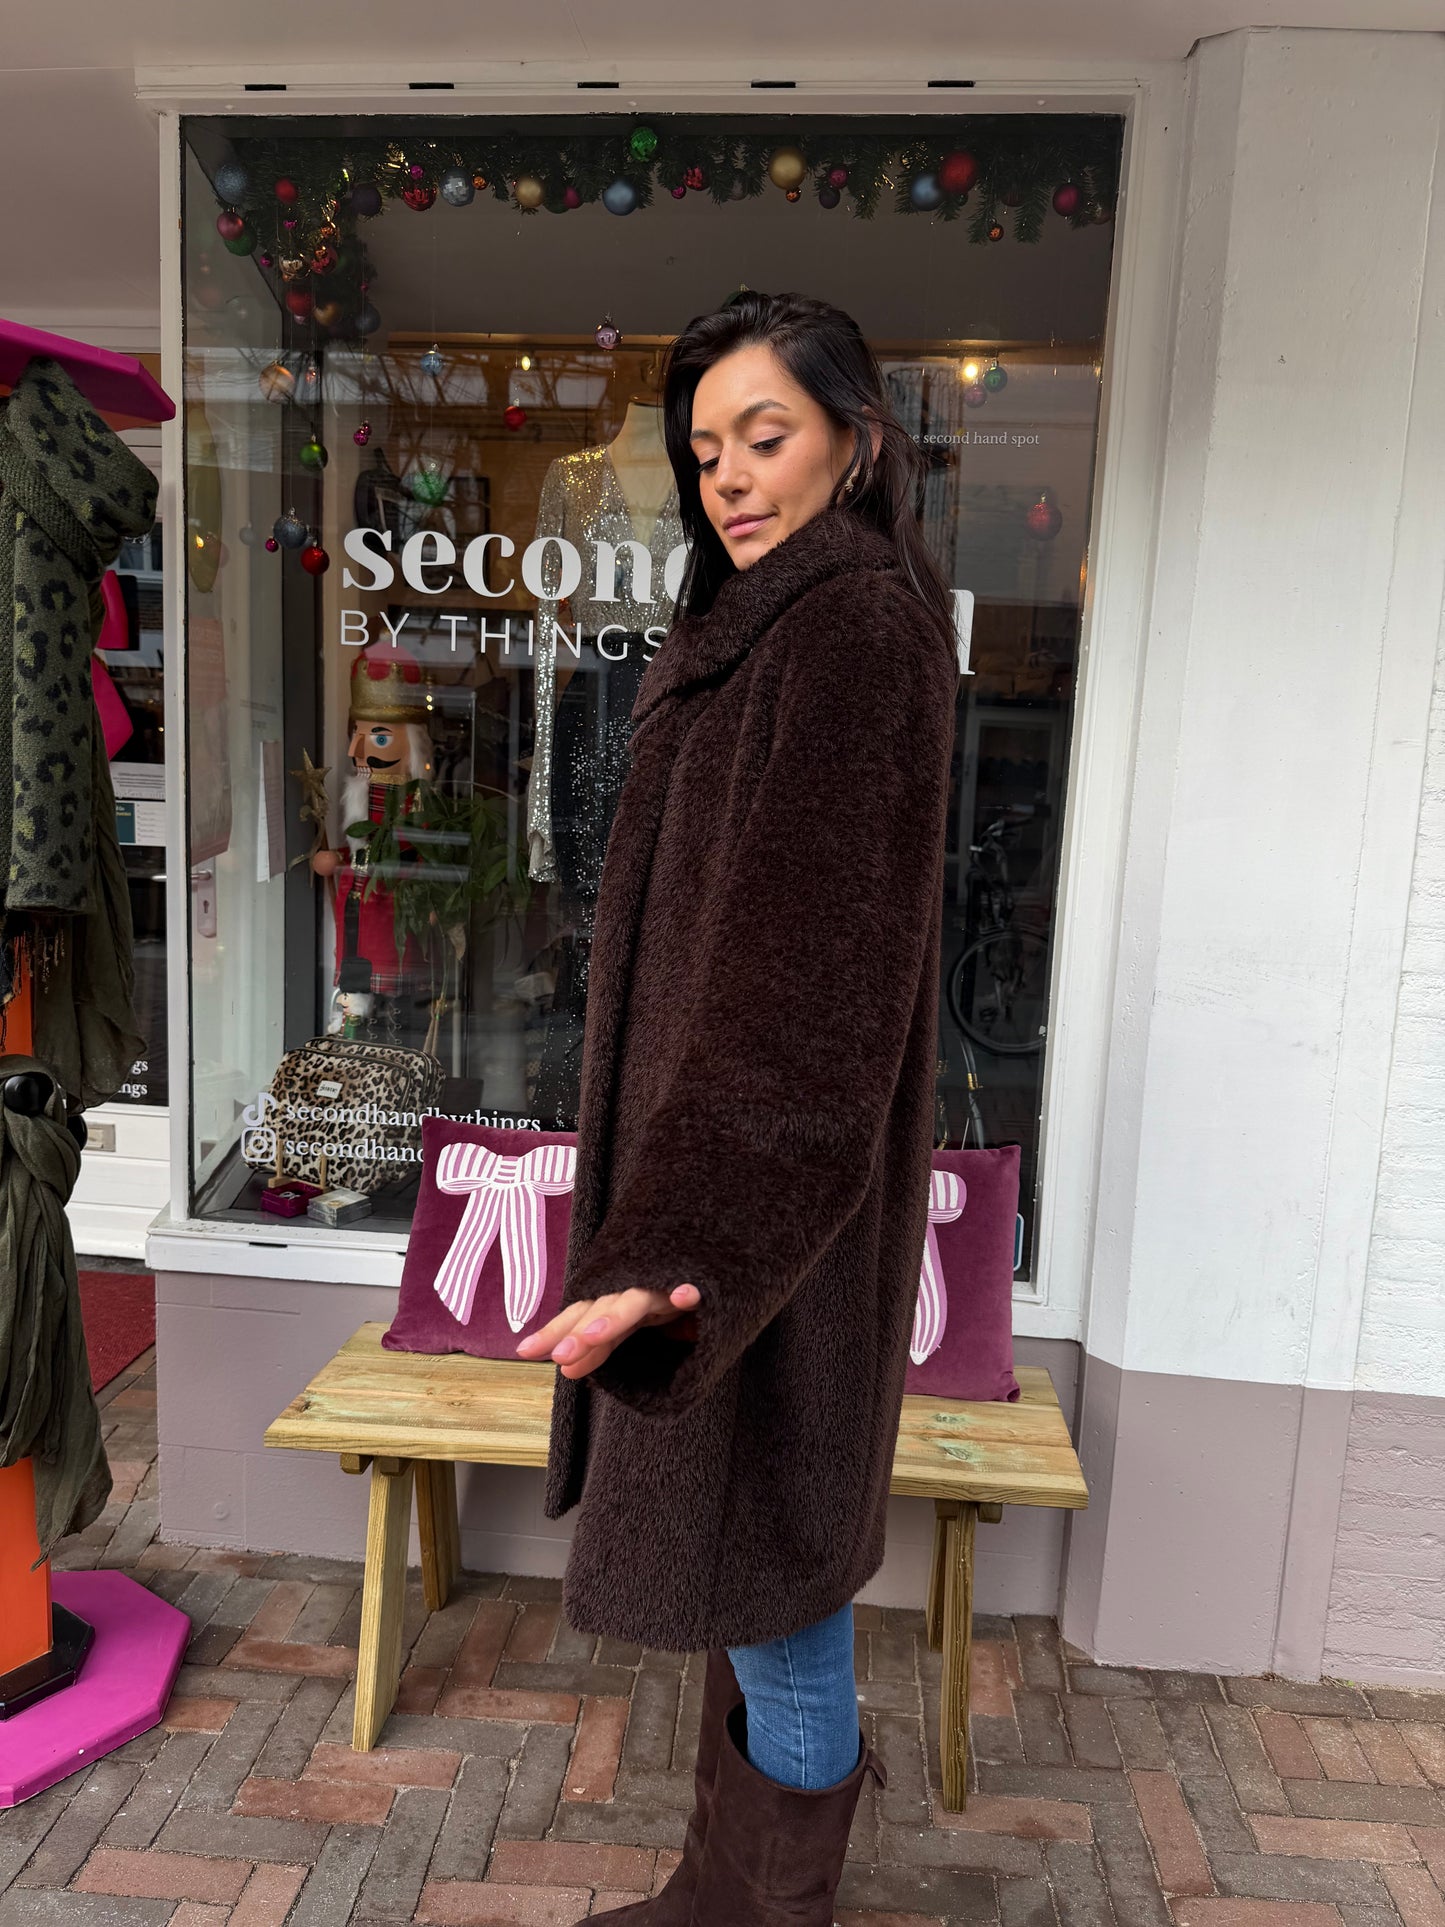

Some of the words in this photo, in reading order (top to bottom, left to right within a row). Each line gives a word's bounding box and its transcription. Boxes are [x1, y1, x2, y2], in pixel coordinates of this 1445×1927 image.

[923, 432, 970, 444] second
[973, 432, 1007, 444] hand
[1011, 434, 1039, 447] spot
[340, 610, 409, 647] BY
[440, 615, 667, 661] THINGS
